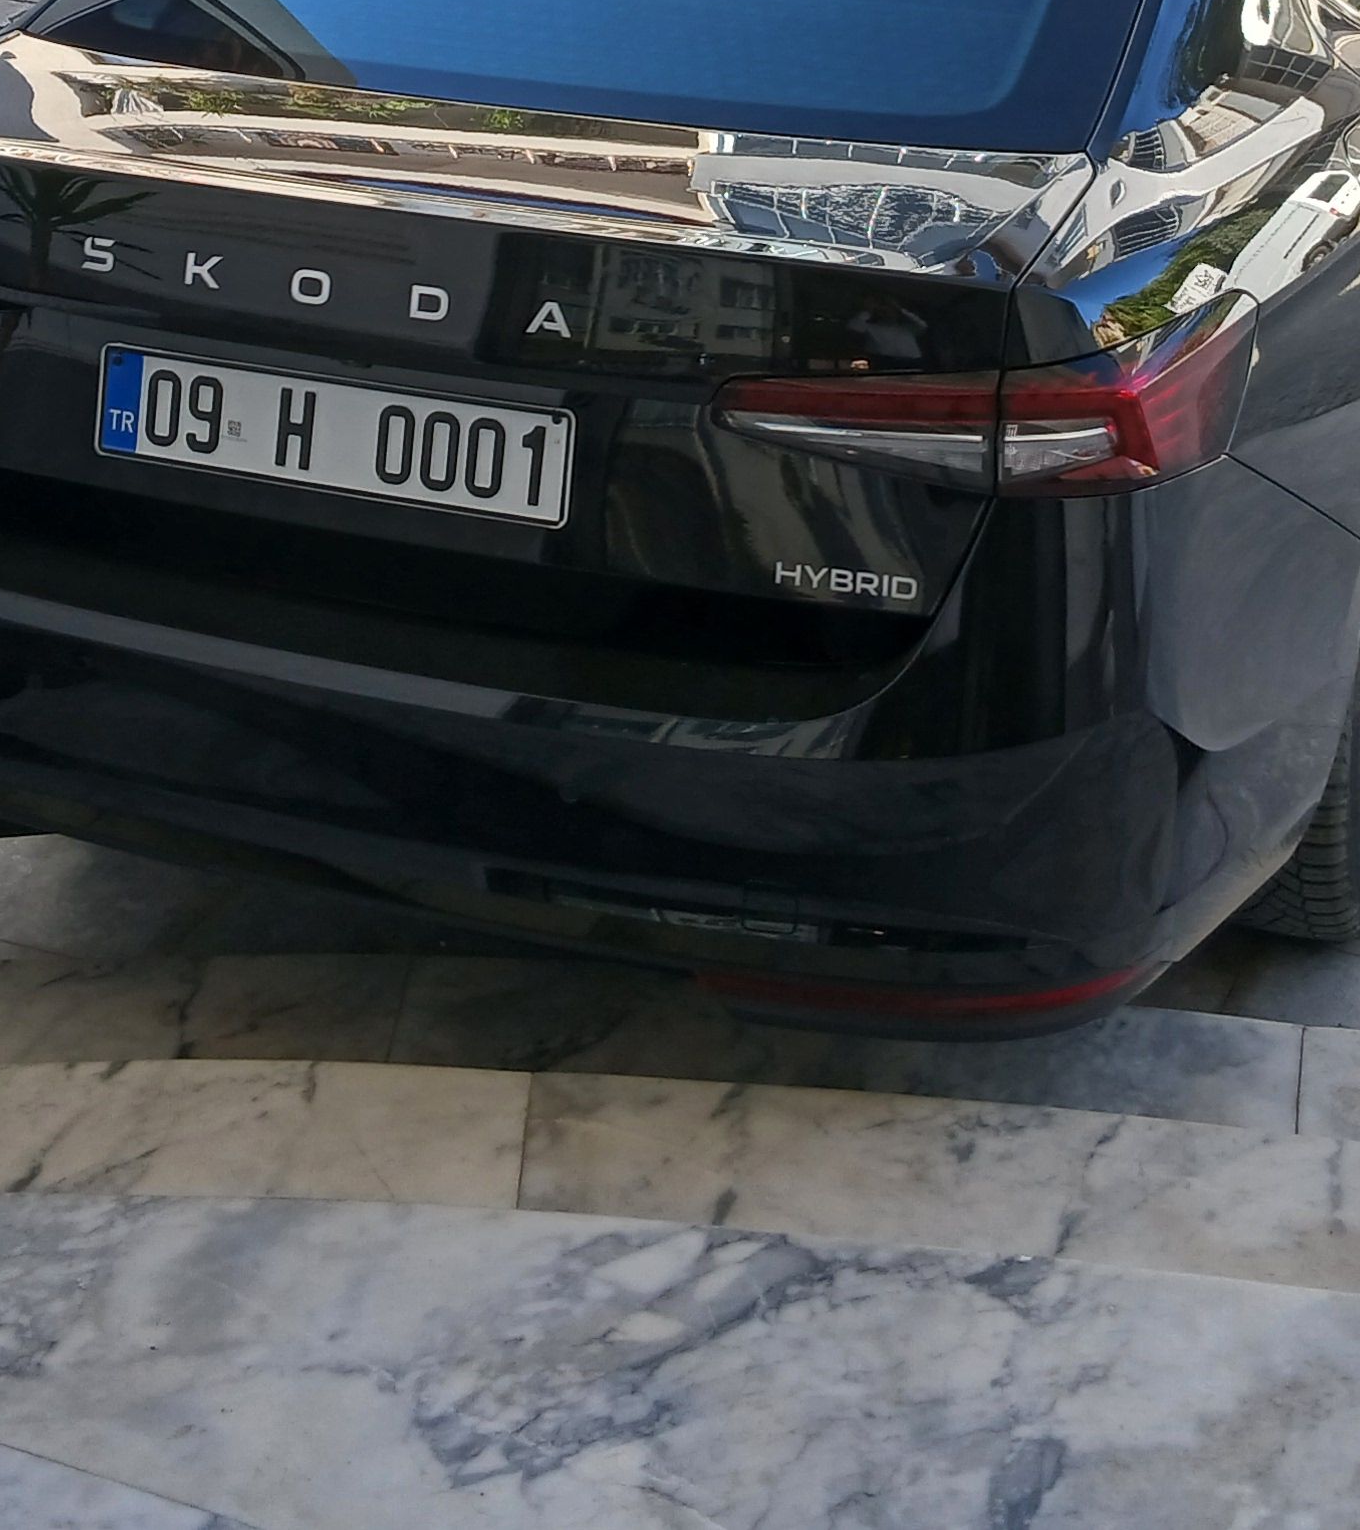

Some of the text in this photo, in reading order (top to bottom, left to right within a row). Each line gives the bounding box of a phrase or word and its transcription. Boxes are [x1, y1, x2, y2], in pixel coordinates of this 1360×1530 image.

[109, 409, 134, 433] TR
[144, 369, 547, 506] 09 H 0001
[775, 561, 917, 600] HYBRID
